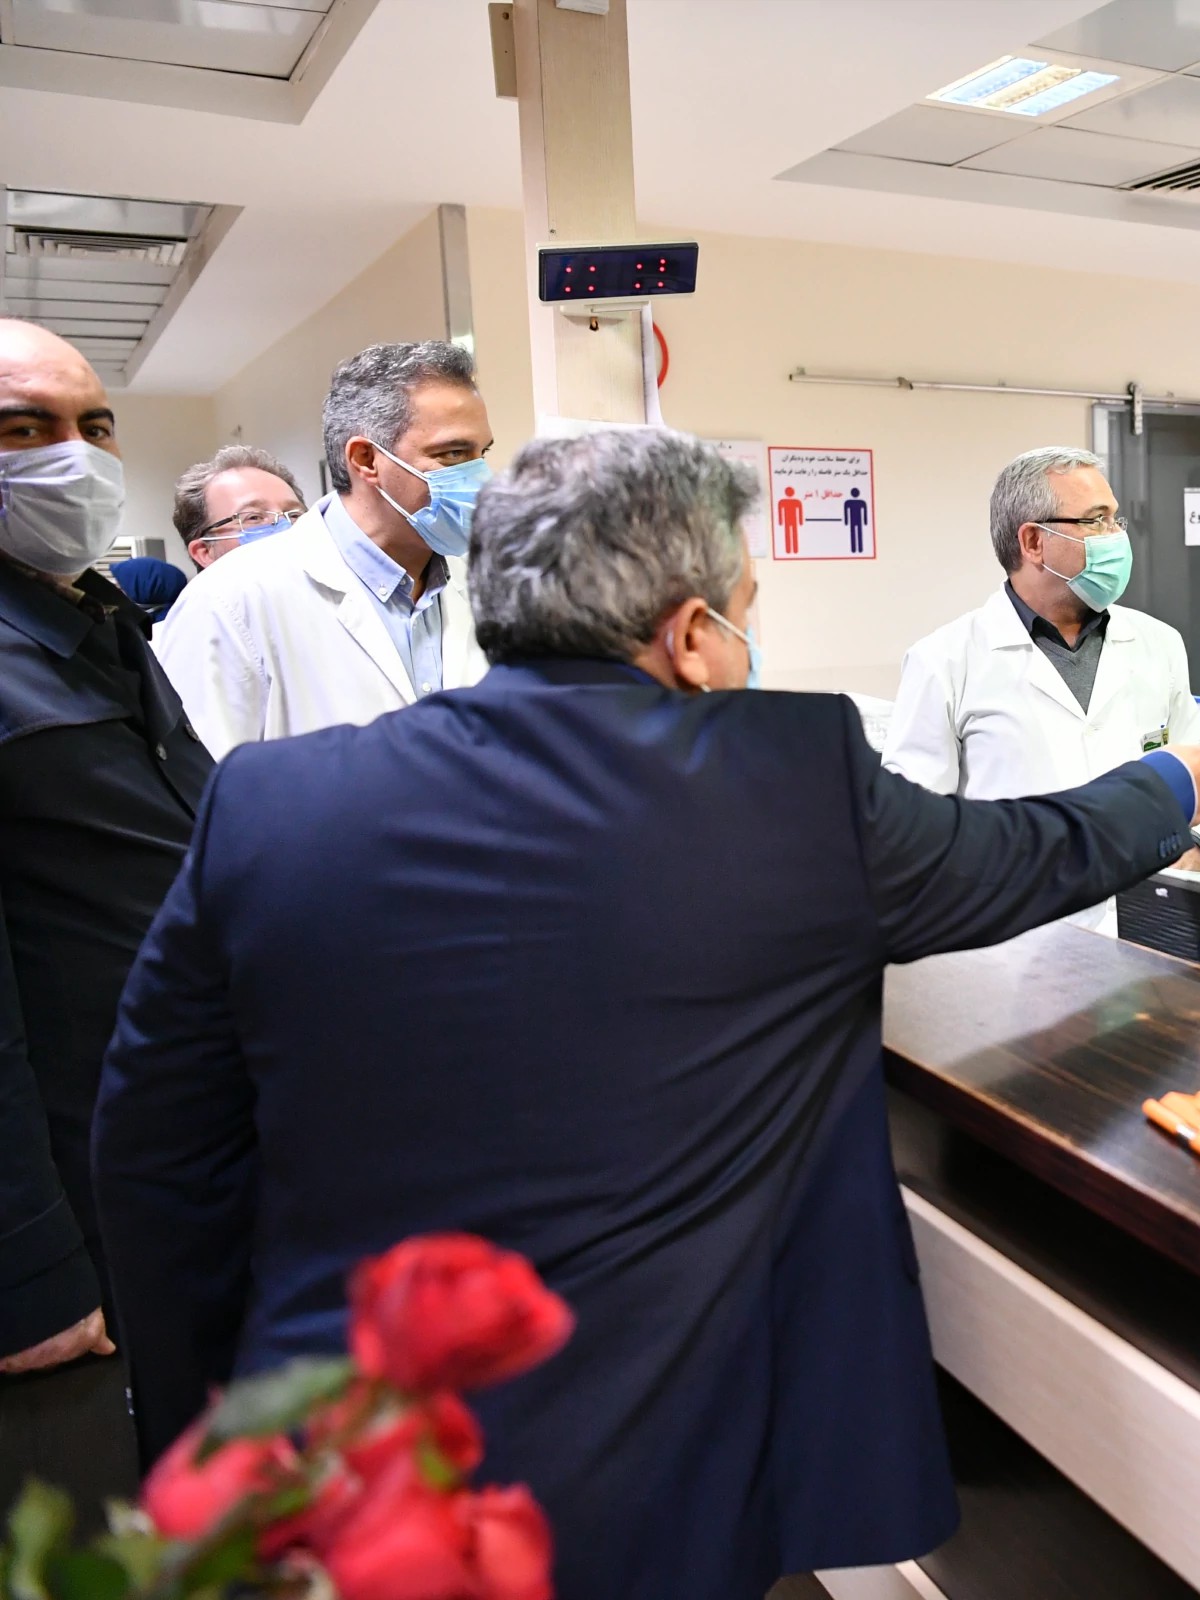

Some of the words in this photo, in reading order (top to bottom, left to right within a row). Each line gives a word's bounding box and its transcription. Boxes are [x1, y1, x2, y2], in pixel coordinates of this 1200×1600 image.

[848, 456, 860, 464] برای
[852, 469, 868, 477] حداقل
[821, 490, 843, 500] حداقل
